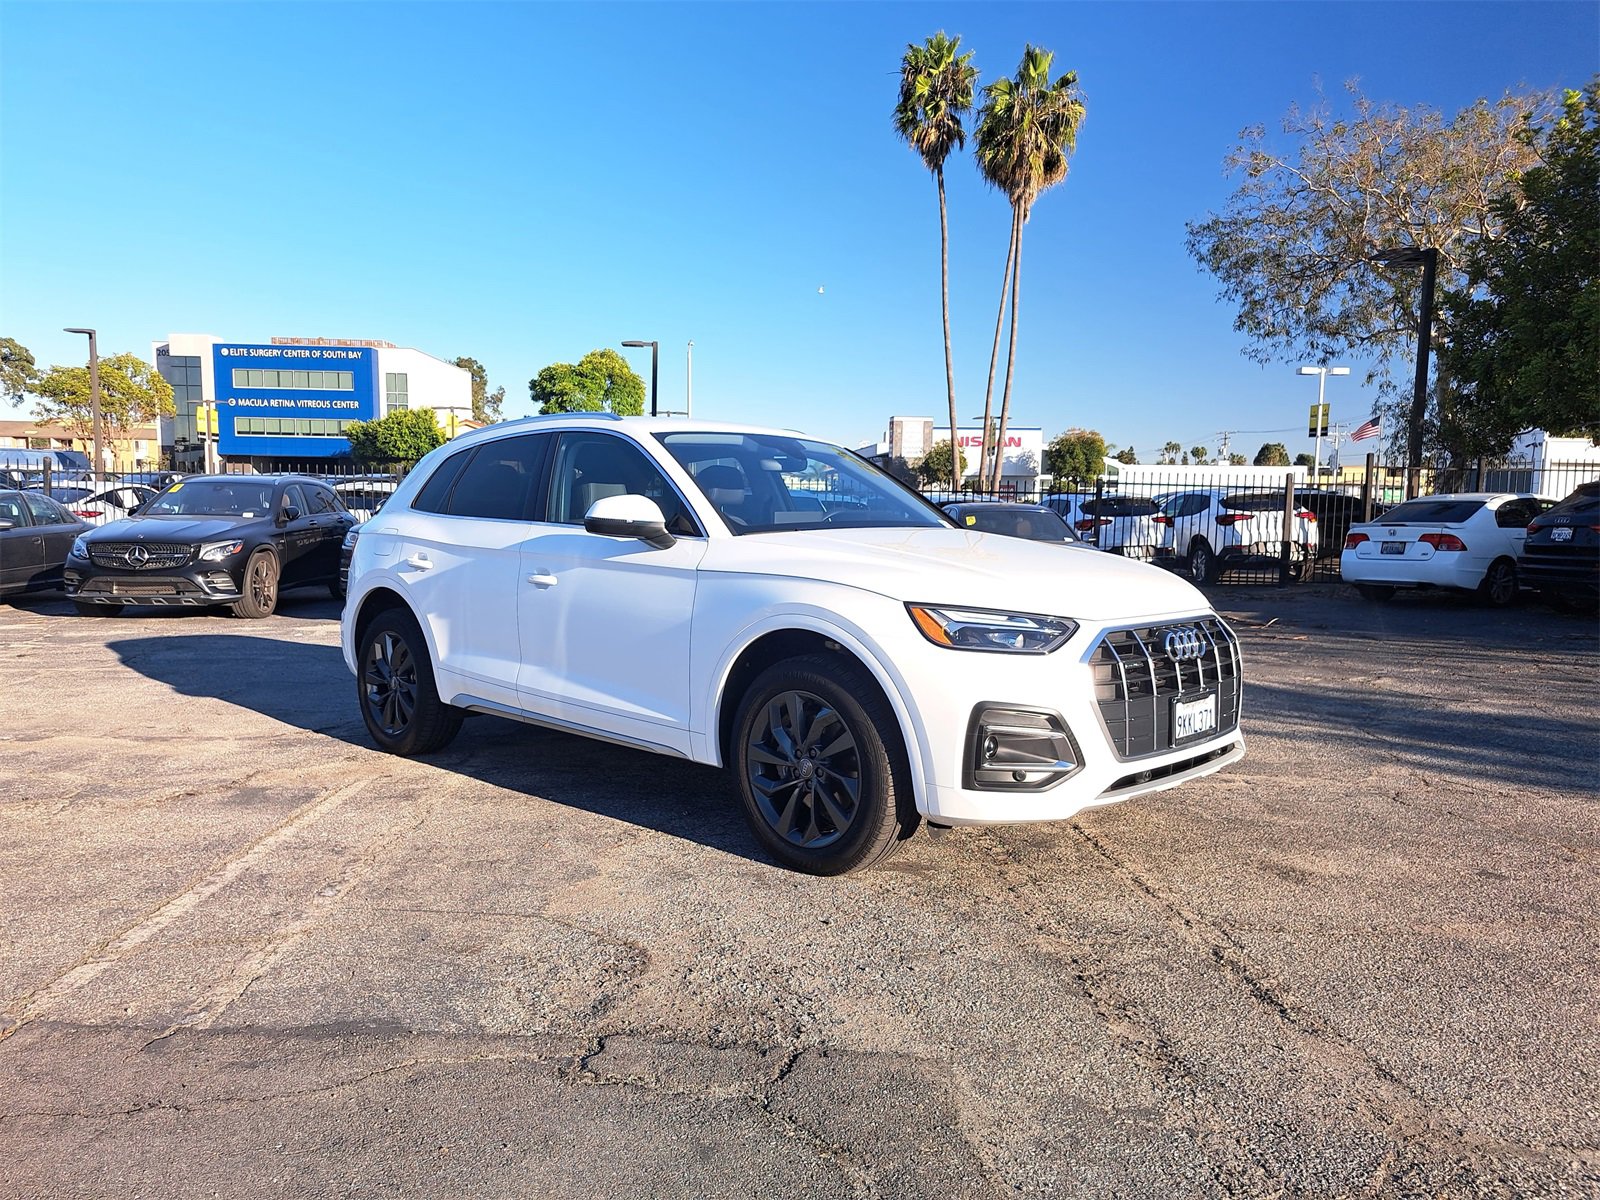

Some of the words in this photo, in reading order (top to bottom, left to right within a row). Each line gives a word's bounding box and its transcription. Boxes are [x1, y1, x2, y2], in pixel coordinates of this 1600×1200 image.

[229, 348, 248, 356] ELITE
[249, 348, 282, 357] SURGERY
[283, 349, 310, 358] CENTER
[311, 350, 321, 358] OF
[322, 350, 347, 359] SOUTH
[348, 351, 363, 359] BAY
[238, 398, 269, 407] MACULA
[270, 399, 296, 408] RETINA
[297, 400, 331, 408] VITREOUS
[332, 400, 360, 409] CENTER
[1177, 708, 1213, 737] 9KKL371
